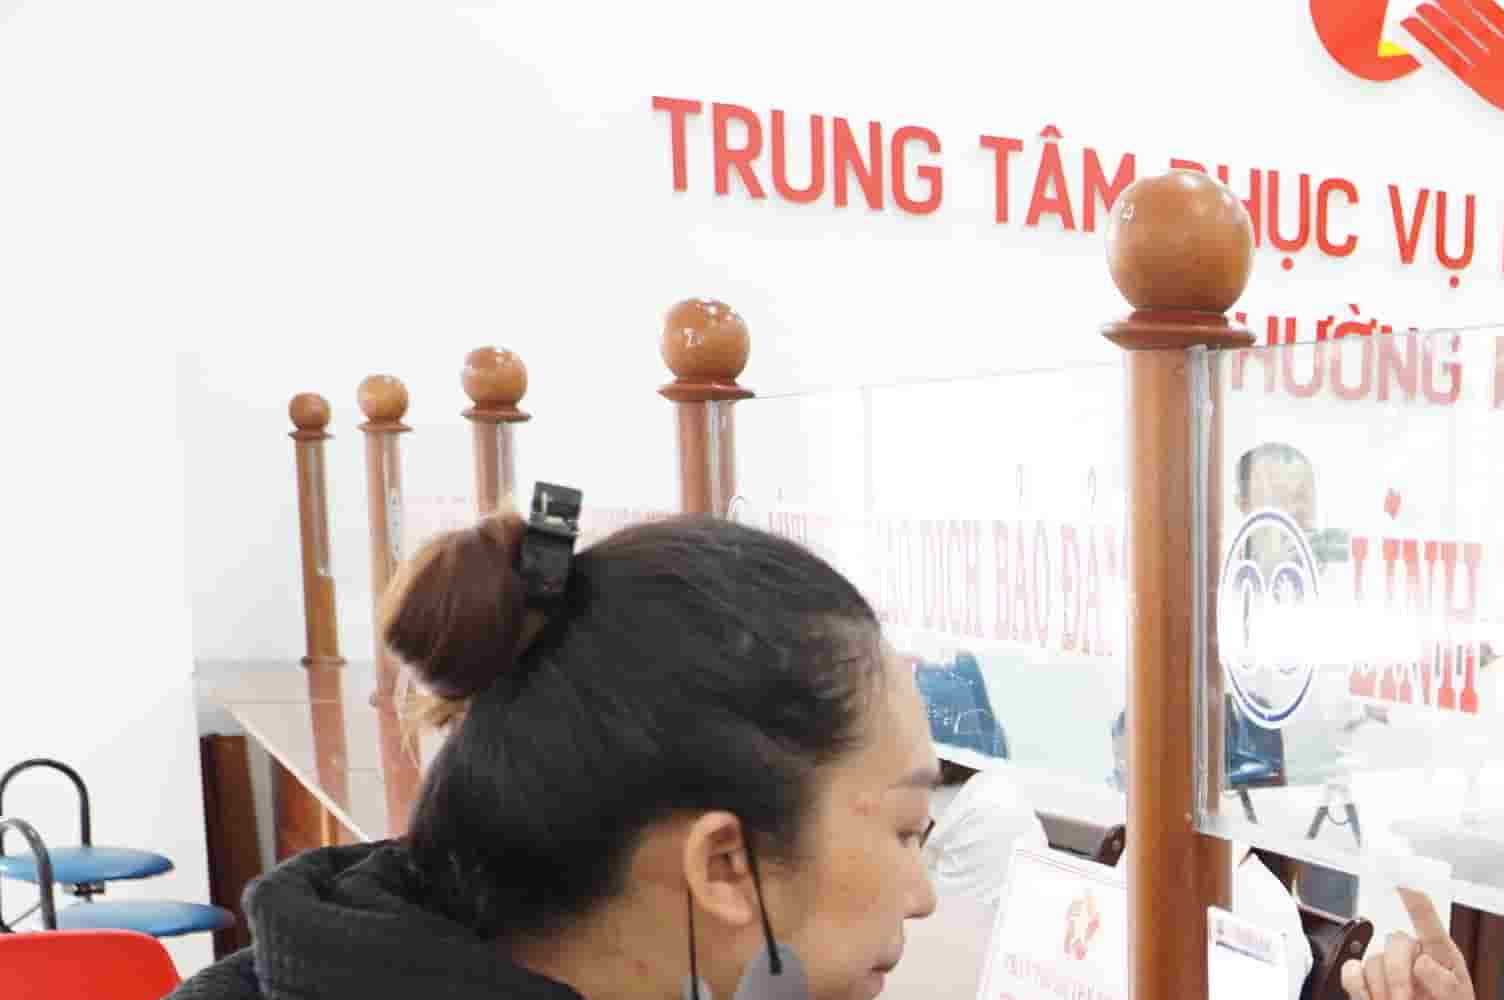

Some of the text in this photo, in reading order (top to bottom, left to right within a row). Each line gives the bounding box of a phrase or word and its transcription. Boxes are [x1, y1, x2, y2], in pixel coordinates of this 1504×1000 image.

[652, 96, 943, 214] TRUNG
[980, 124, 1137, 233] TÂM
[1169, 158, 1360, 271] HỤC
[1387, 184, 1477, 288] VỤ
[1231, 304, 1464, 407] HƯỜNG
